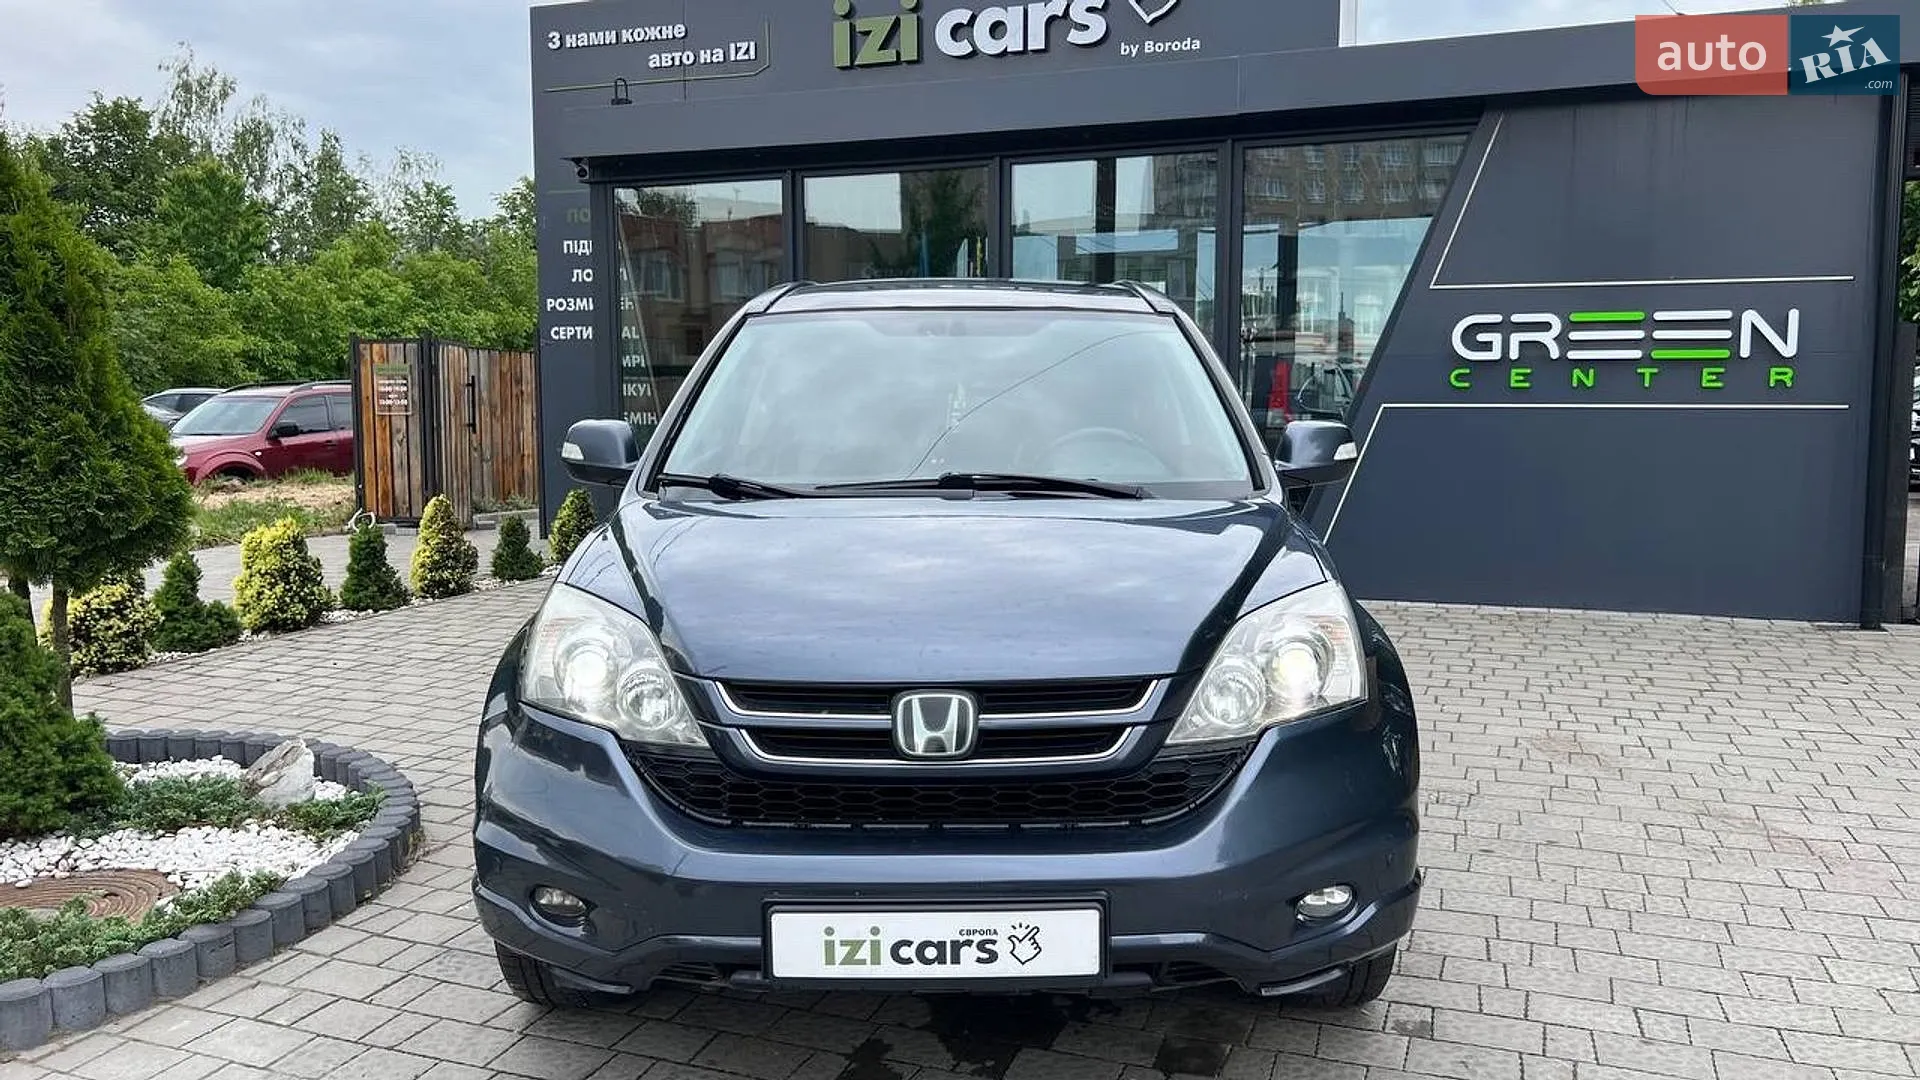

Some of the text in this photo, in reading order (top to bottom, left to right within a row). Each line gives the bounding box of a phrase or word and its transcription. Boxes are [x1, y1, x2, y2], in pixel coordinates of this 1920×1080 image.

[548, 23, 687, 49] З нами кожне
[832, 0, 1107, 67] izi cars
[1120, 37, 1201, 57] by Boroda
[649, 41, 756, 69] авто на IZI
[551, 326, 592, 340] СЕРТИ
[1451, 308, 1799, 361] GREEN
[1450, 367, 1795, 389] CENTER
[823, 926, 998, 966] izi cars
